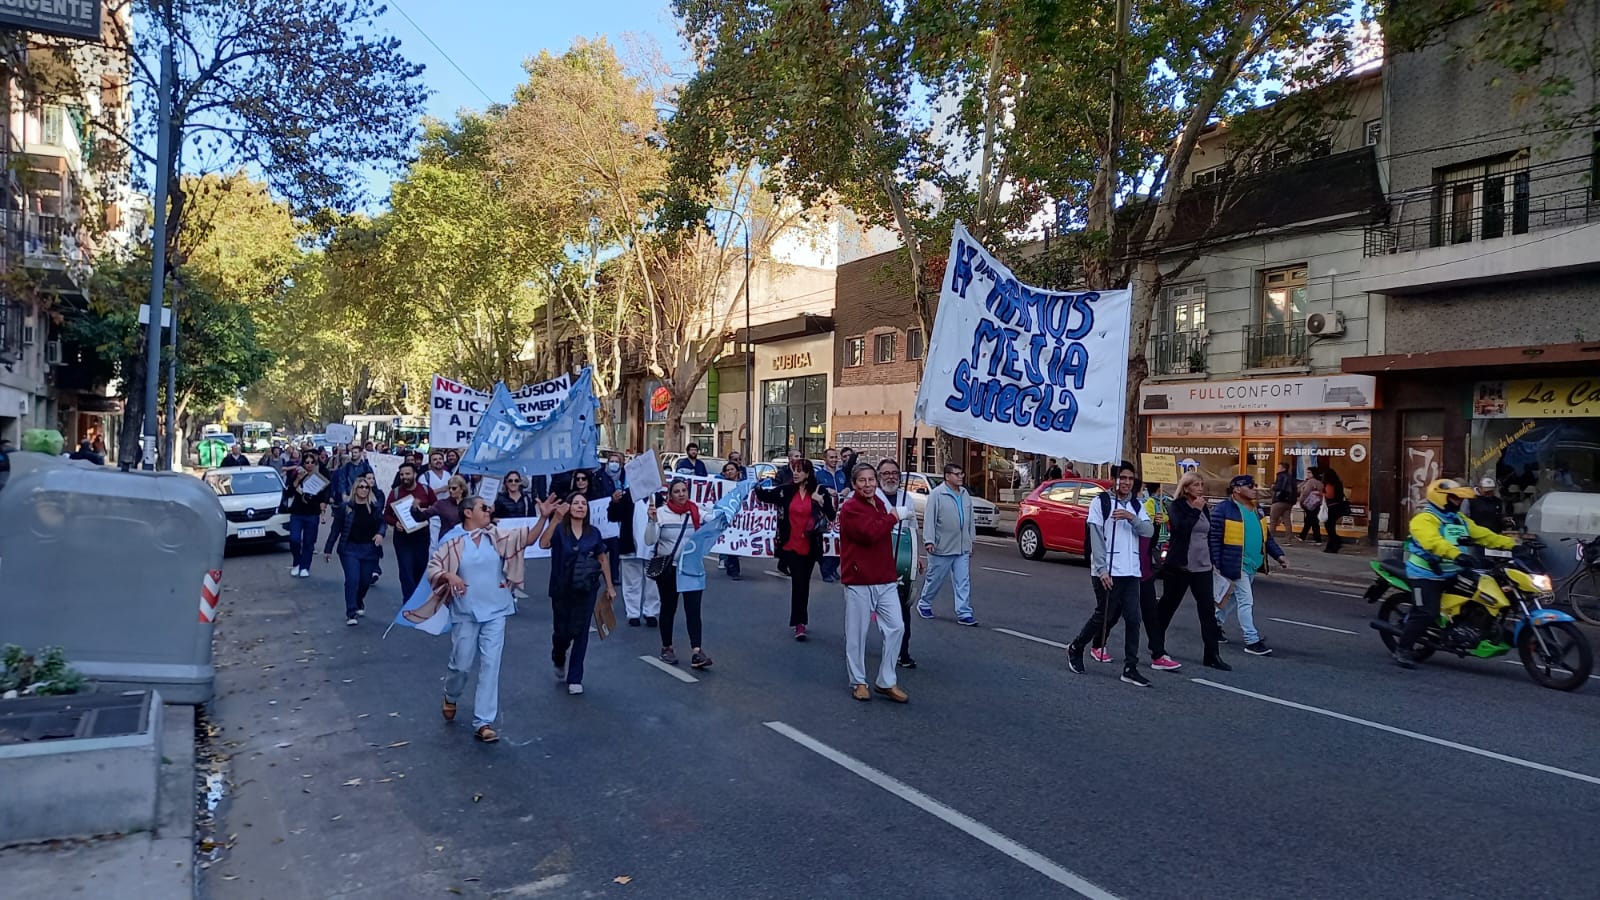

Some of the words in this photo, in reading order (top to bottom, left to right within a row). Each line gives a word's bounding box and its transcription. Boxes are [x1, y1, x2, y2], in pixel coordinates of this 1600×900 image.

[436, 377, 462, 394] NO
[1190, 383, 1303, 400] FULLCONFORT
[1517, 382, 1556, 404] La
[1566, 380, 1600, 407] Ca
[434, 396, 453, 410] DE
[449, 414, 461, 426] A
[1152, 446, 1184, 454] ENTREGA
[1186, 447, 1228, 455] INMEDIATA
[1284, 447, 1347, 457] FABRICANTES
